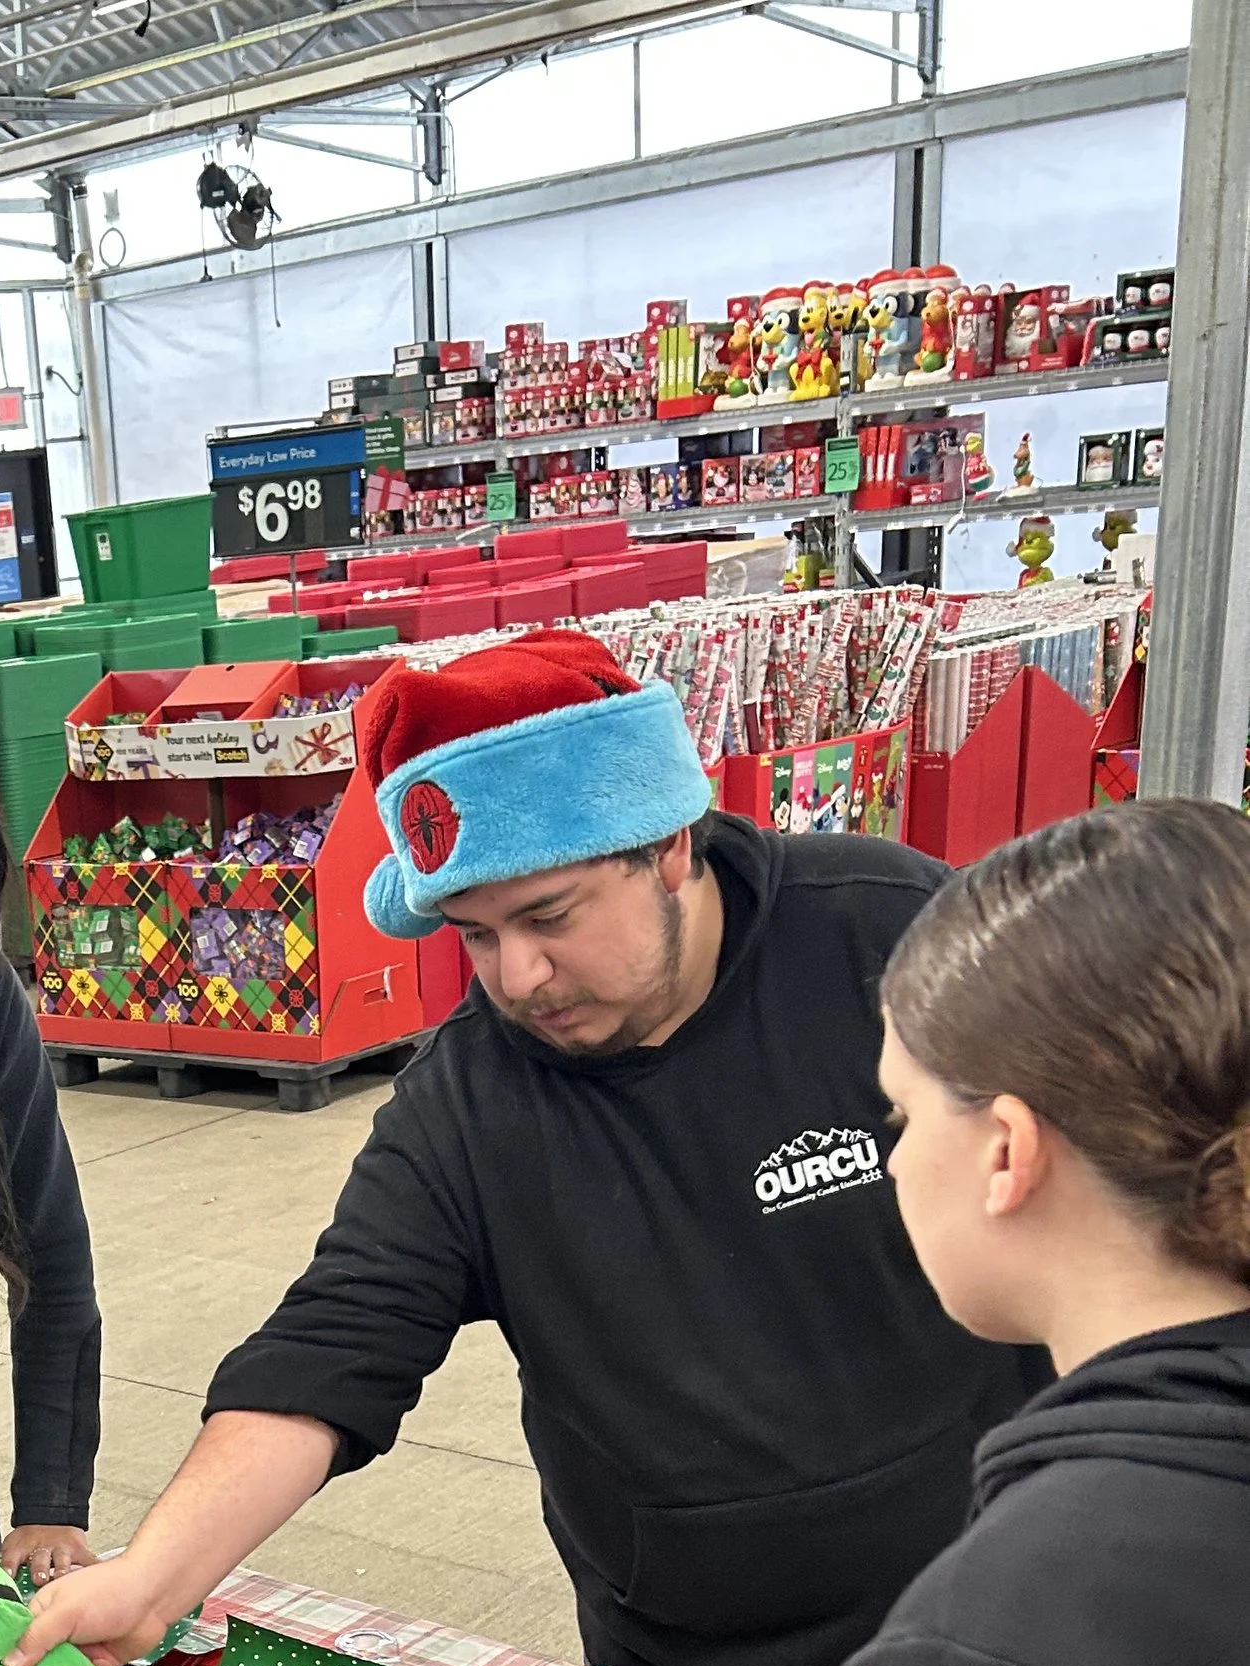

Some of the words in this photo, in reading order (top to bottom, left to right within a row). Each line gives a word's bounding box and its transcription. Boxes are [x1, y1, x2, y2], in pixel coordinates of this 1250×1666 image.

[219, 453, 266, 469] Everyday
[267, 452, 287, 463] Low
[289, 448, 317, 460] Price
[829, 461, 847, 481] 25
[165, 737, 184, 746] Your
[186, 736, 206, 745] next
[207, 733, 240, 746] holiday
[167, 752, 194, 762] starts
[195, 751, 213, 761] with
[215, 749, 249, 762] Scotch
[43, 975, 63, 990] 100
[177, 983, 199, 998] 100
[754, 1138, 879, 1202] OURCU
